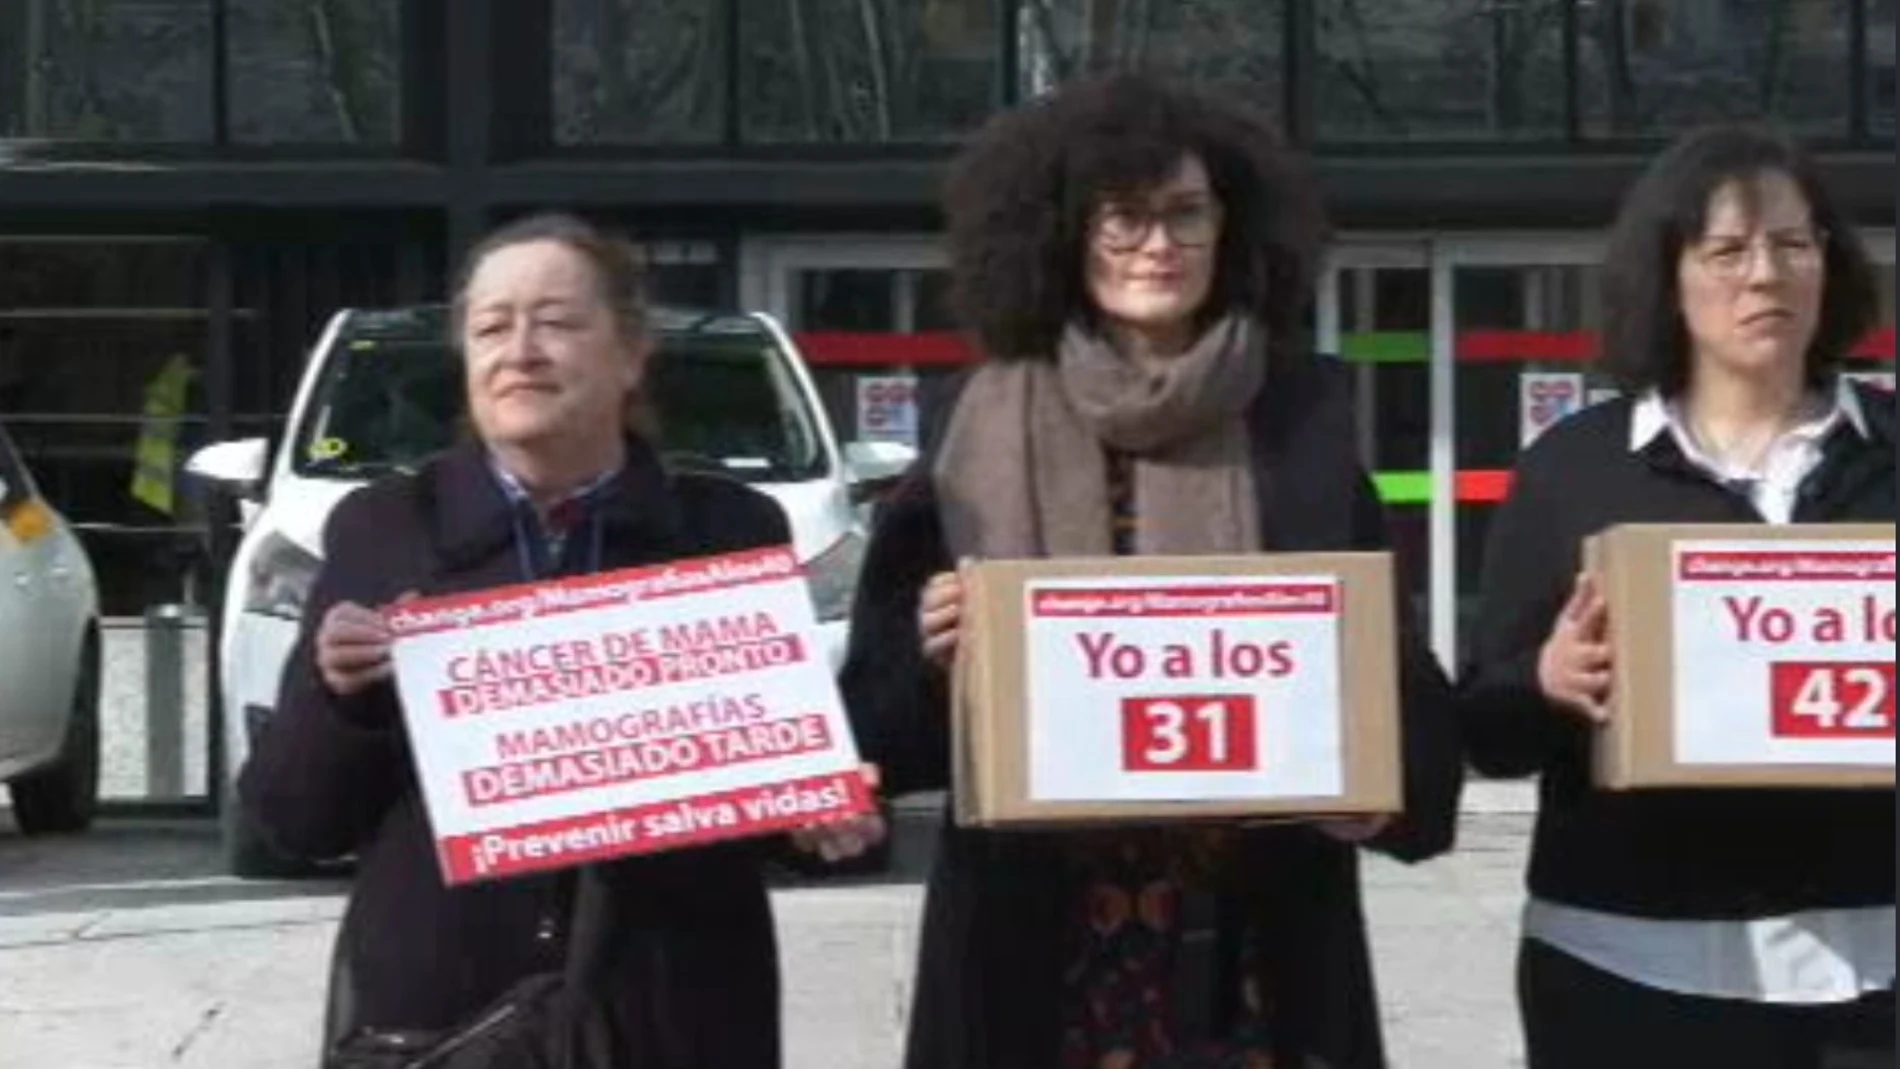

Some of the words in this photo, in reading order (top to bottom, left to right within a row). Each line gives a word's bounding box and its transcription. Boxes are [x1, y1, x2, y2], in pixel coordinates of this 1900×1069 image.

[447, 636, 592, 685] CÁNCER
[602, 630, 652, 659] DE
[660, 610, 778, 652] MAMA
[1722, 596, 1795, 643] Yo
[1813, 607, 1843, 643] a
[455, 663, 650, 715] DEMASIADO
[658, 640, 789, 684] PRONTO
[1076, 632, 1144, 678] Yo
[1162, 644, 1193, 678] a
[1212, 628, 1293, 678] los
[497, 694, 764, 758] MAMOGRAFÍAS
[1791, 668, 1889, 728] 42
[470, 737, 698, 801] DEMASIADO
[706, 718, 826, 759] TARDE
[1144, 701, 1229, 764] 31
[473, 820, 636, 873] ¡Prevenir
[644, 801, 738, 838] salva
[744, 780, 851, 820] vidas!
